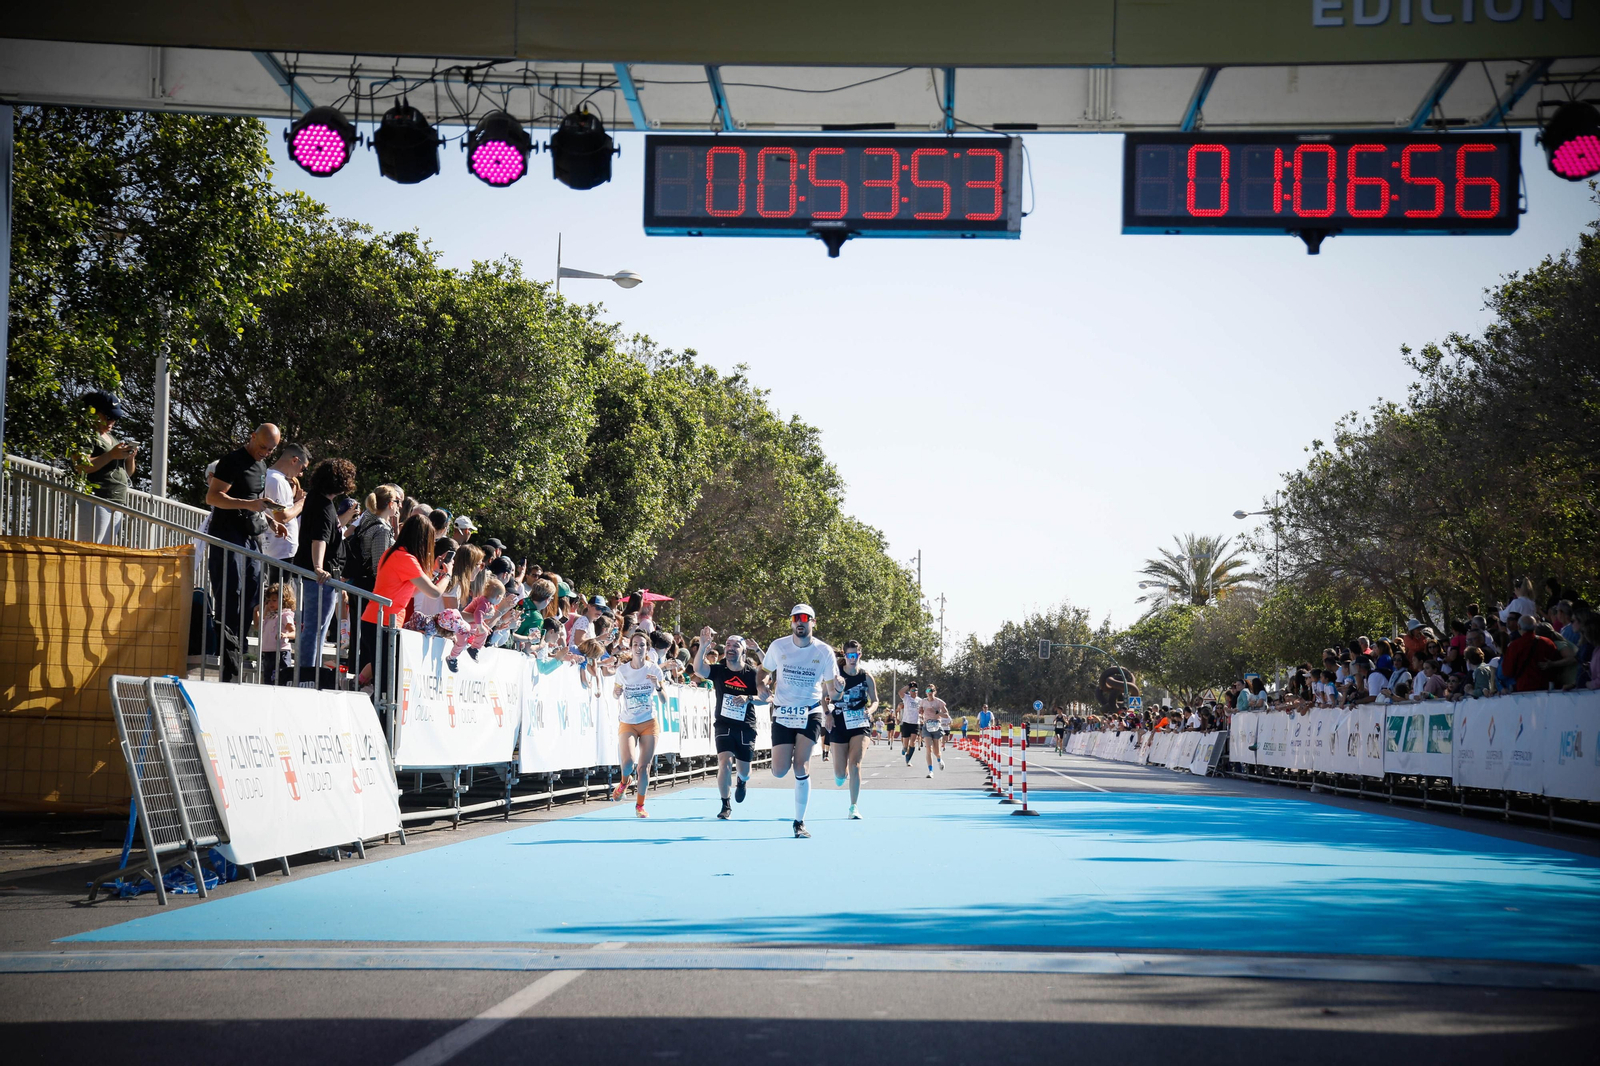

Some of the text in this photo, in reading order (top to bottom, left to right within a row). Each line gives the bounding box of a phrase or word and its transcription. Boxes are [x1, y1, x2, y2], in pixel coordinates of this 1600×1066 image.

[705, 146, 1003, 221] 00:53:53
[1186, 144, 1500, 218] 01:06:56
[780, 706, 805, 715] 5415
